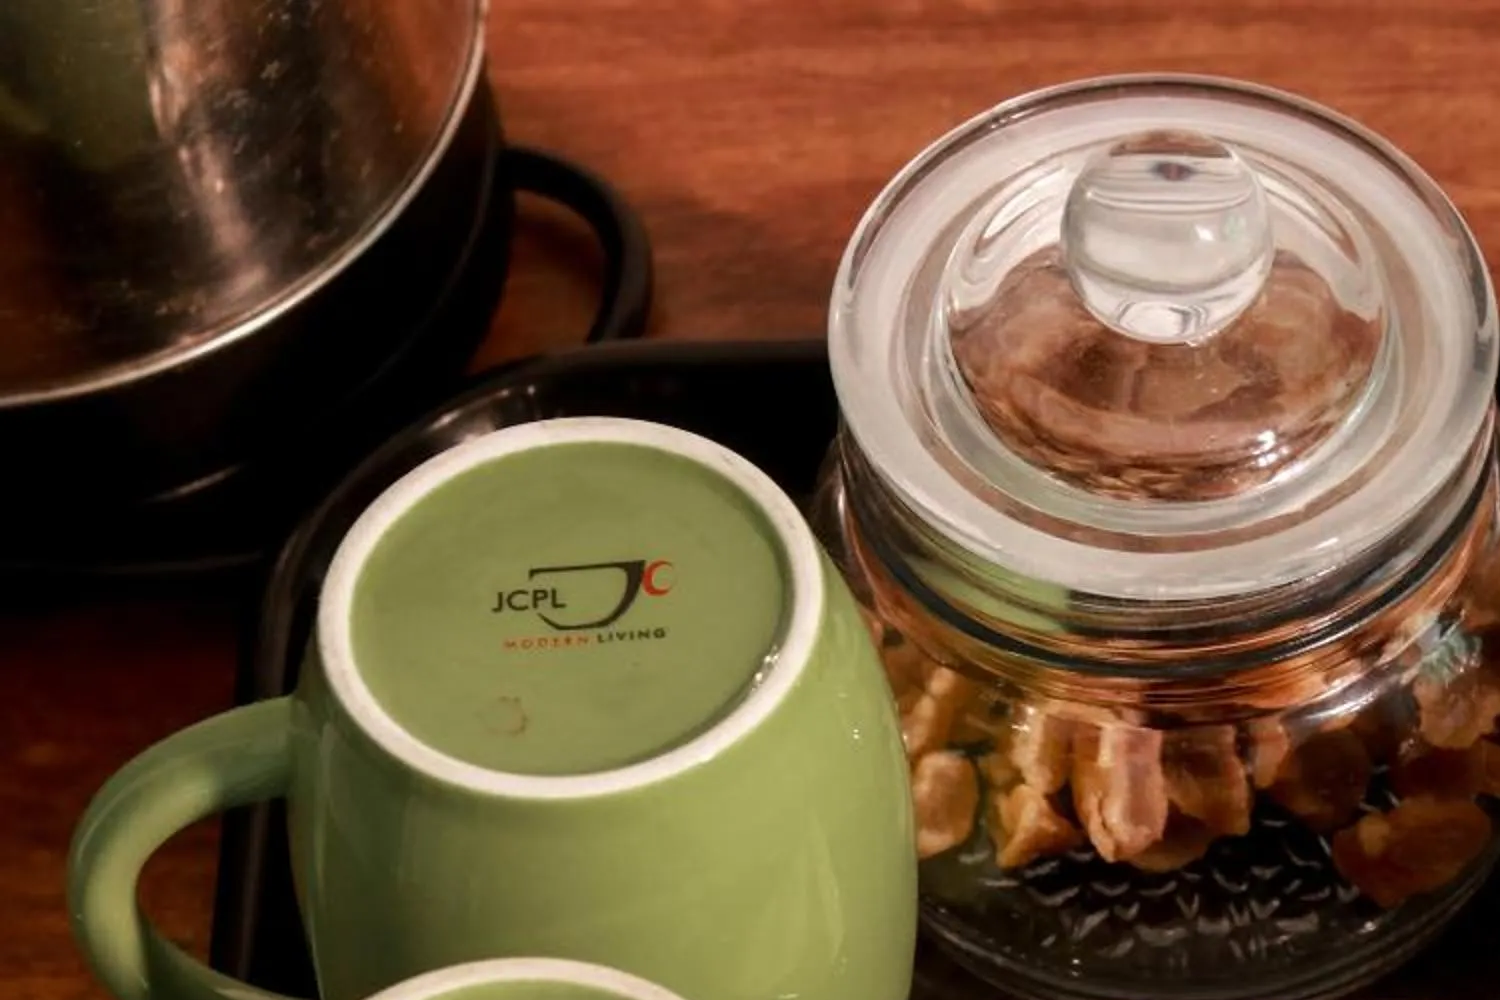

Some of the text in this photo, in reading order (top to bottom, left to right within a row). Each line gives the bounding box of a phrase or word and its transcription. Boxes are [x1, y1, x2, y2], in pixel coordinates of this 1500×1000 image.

[491, 587, 567, 613] JCPL
[503, 628, 667, 651] MODERN LIVING
